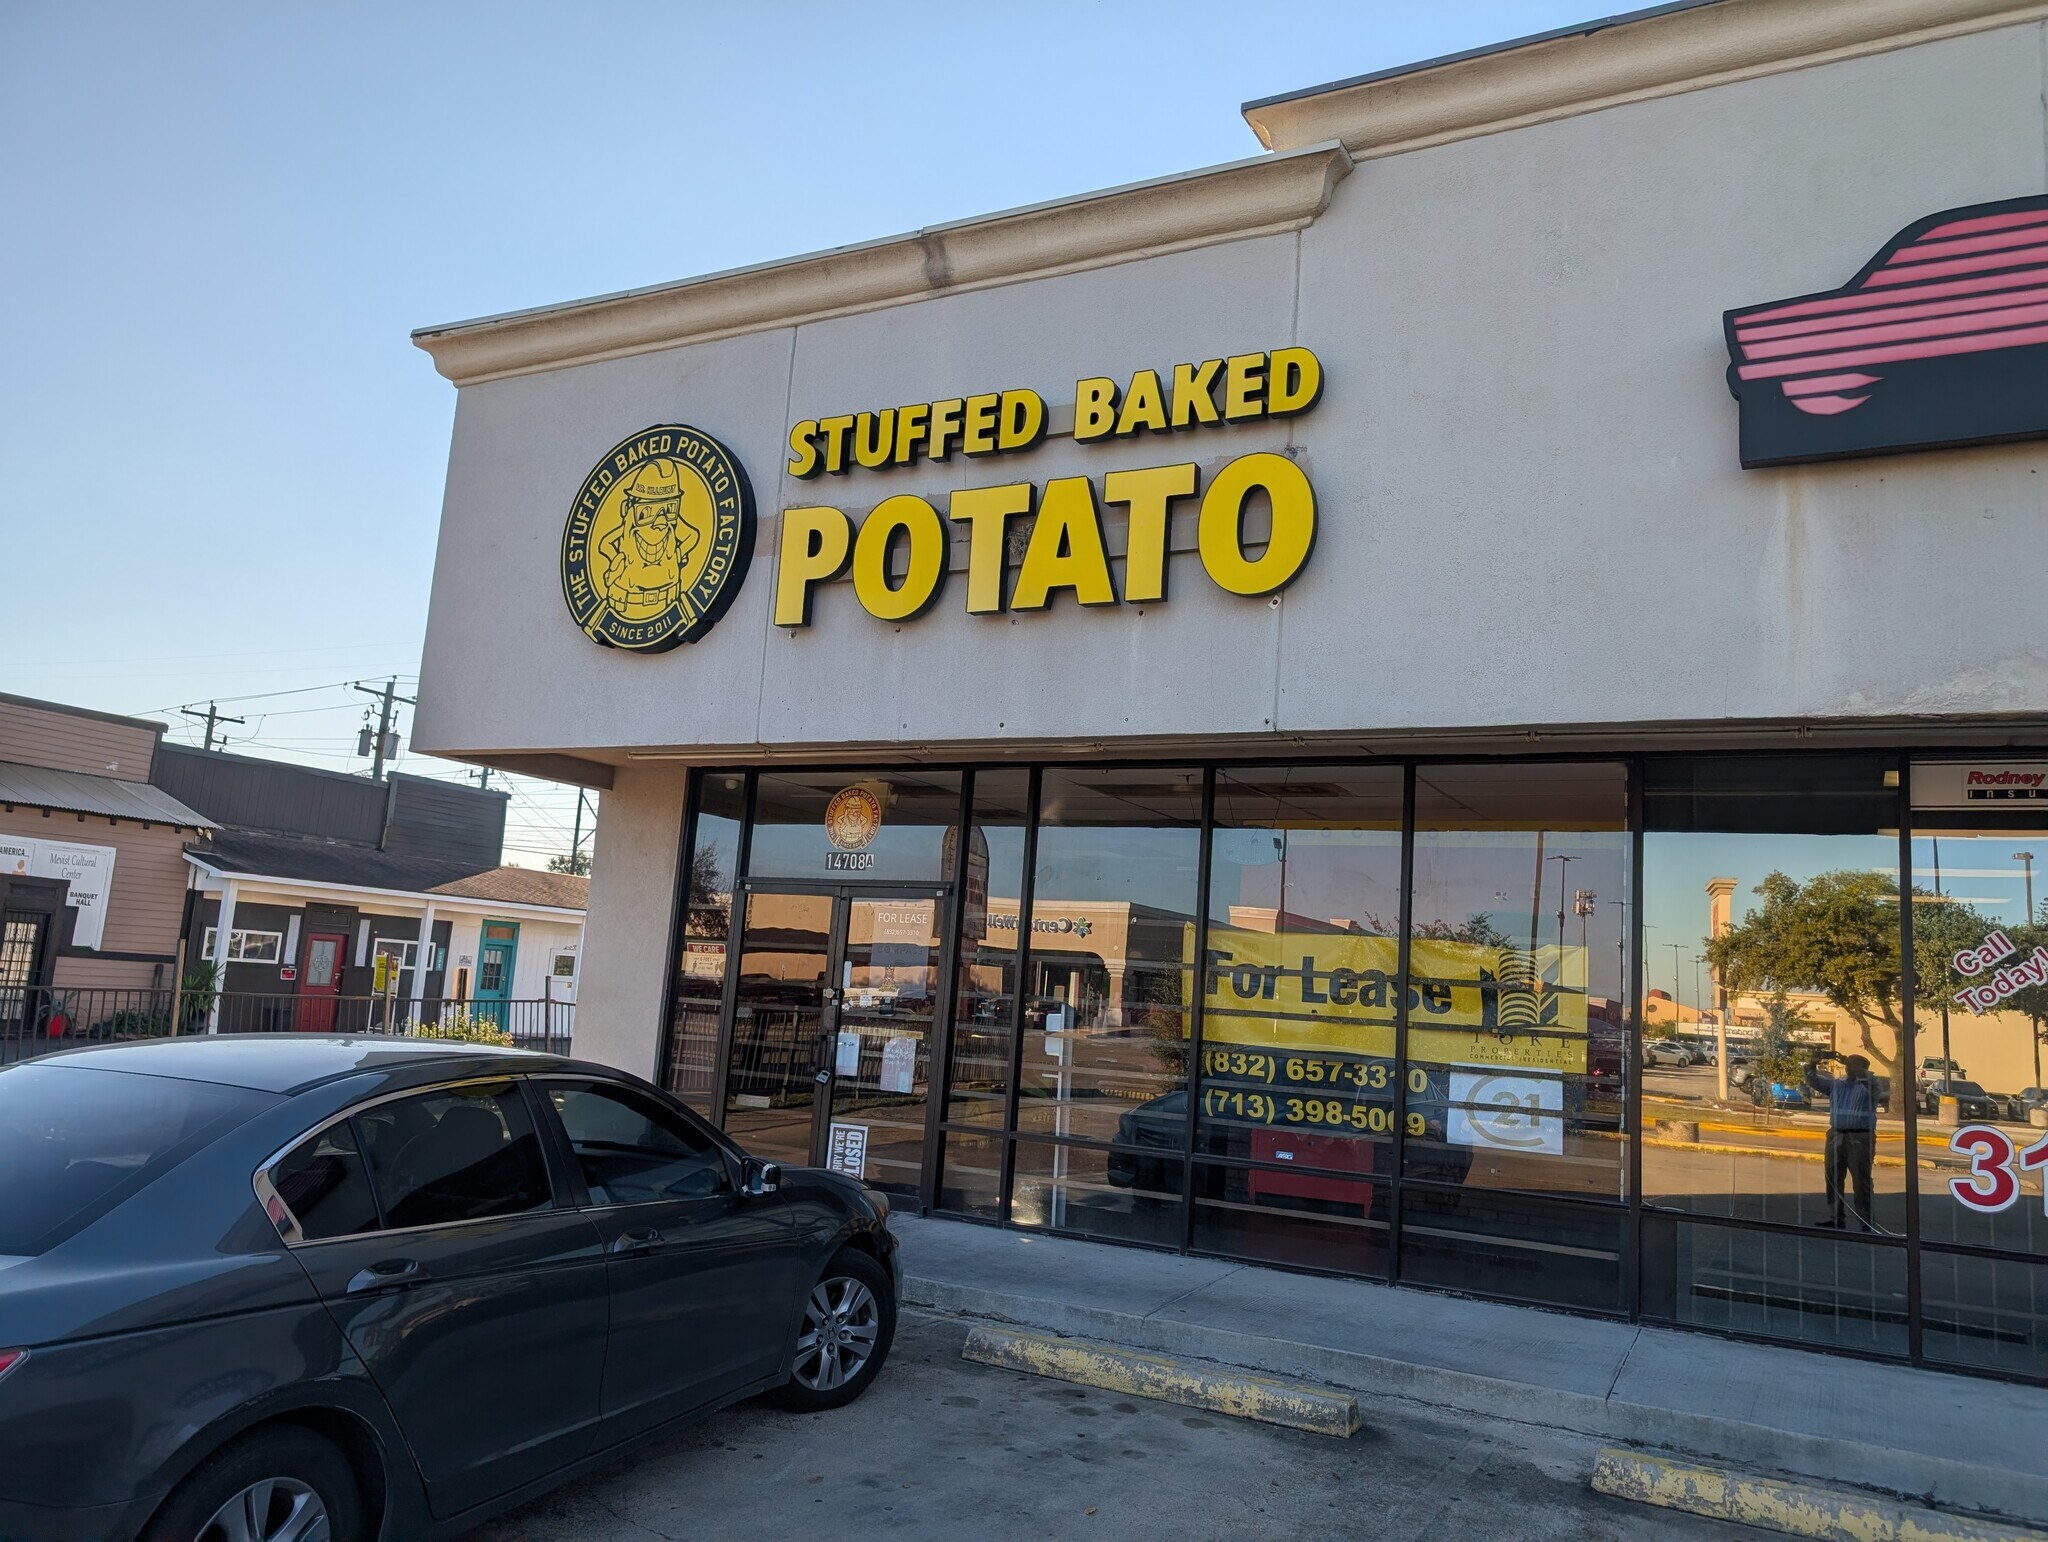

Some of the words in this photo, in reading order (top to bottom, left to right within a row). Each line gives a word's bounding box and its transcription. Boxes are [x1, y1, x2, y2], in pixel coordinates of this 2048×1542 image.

[788, 388, 1048, 480] STUFFED
[1073, 347, 1325, 445] BAKED
[614, 434, 673, 473] BAKED
[676, 435, 730, 494] POTATO
[568, 469, 615, 563] STUFFED
[698, 497, 736, 600] FACTORY
[773, 451, 1319, 628] POTATO
[570, 569, 592, 611] THE
[608, 622, 644, 641] SINCE
[646, 618, 673, 638] 2011
[1967, 770, 2046, 788] Rodney
[860, 791, 878, 808] POTATO
[61, 867, 82, 880] Center
[71, 855, 98, 868] Cultural
[70, 892, 98, 900] BANQUET
[75, 898, 91, 907] HALL
[878, 912, 897, 924] FOR
[899, 913, 929, 925] LEASE
[692, 944, 703, 953] WE
[703, 945, 720, 954] CARE
[1954, 931, 2016, 976] Call
[1205, 949, 1285, 1001] For
[1300, 955, 1453, 1016] Lease
[1204, 1050, 1277, 1084] (832)
[1471, 1046, 1573, 1058] PROPERTIES
[1204, 1088, 1276, 1125] (713)
[844, 1132, 862, 1175] LOSED
